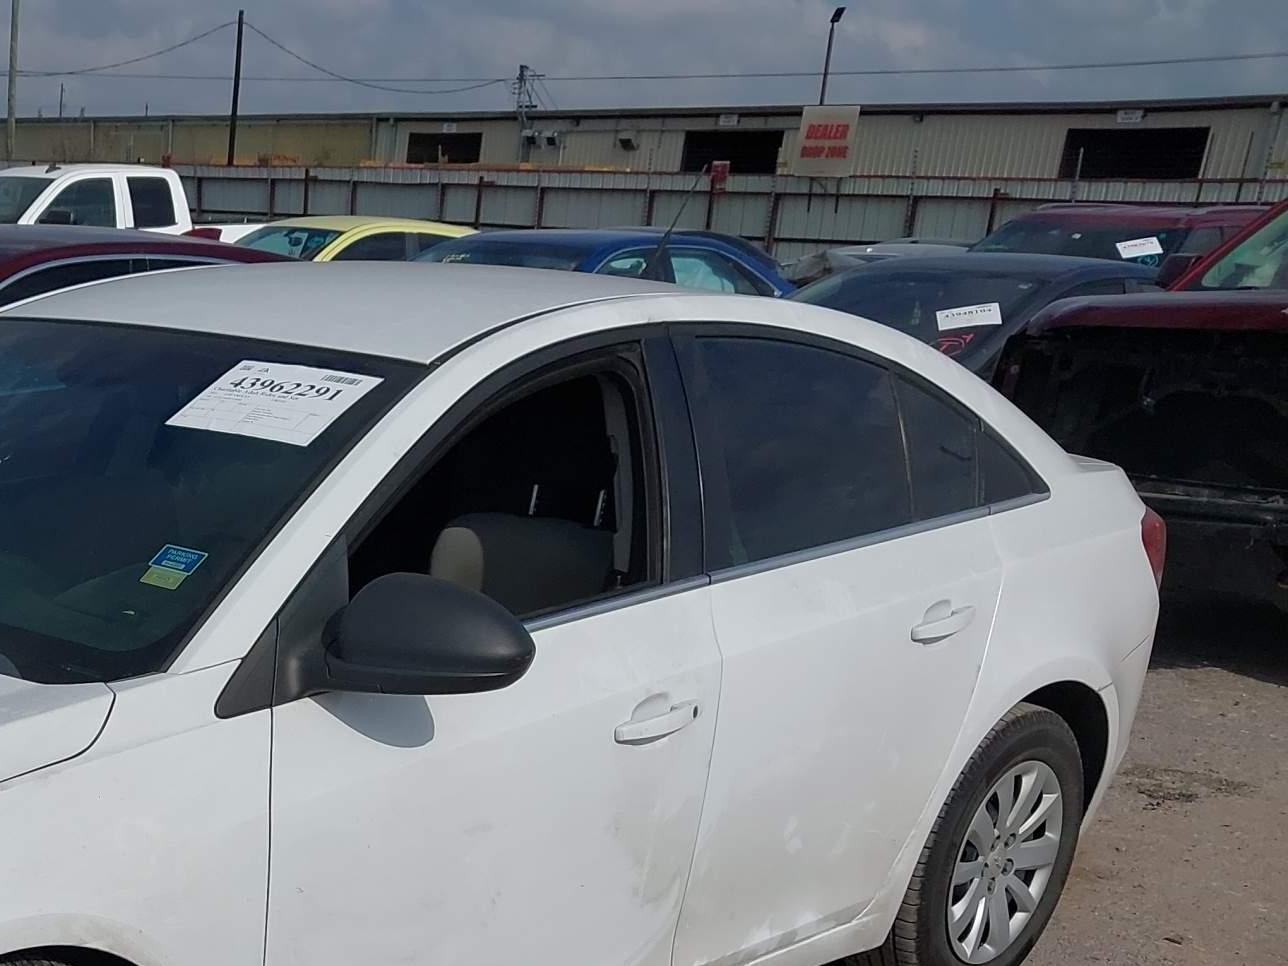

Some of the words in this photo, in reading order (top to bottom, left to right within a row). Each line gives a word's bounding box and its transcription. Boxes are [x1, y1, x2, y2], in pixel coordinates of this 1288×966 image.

[805, 124, 849, 140] DEALER
[229, 376, 344, 401] 43962291
[167, 548, 199, 560] PARKING
